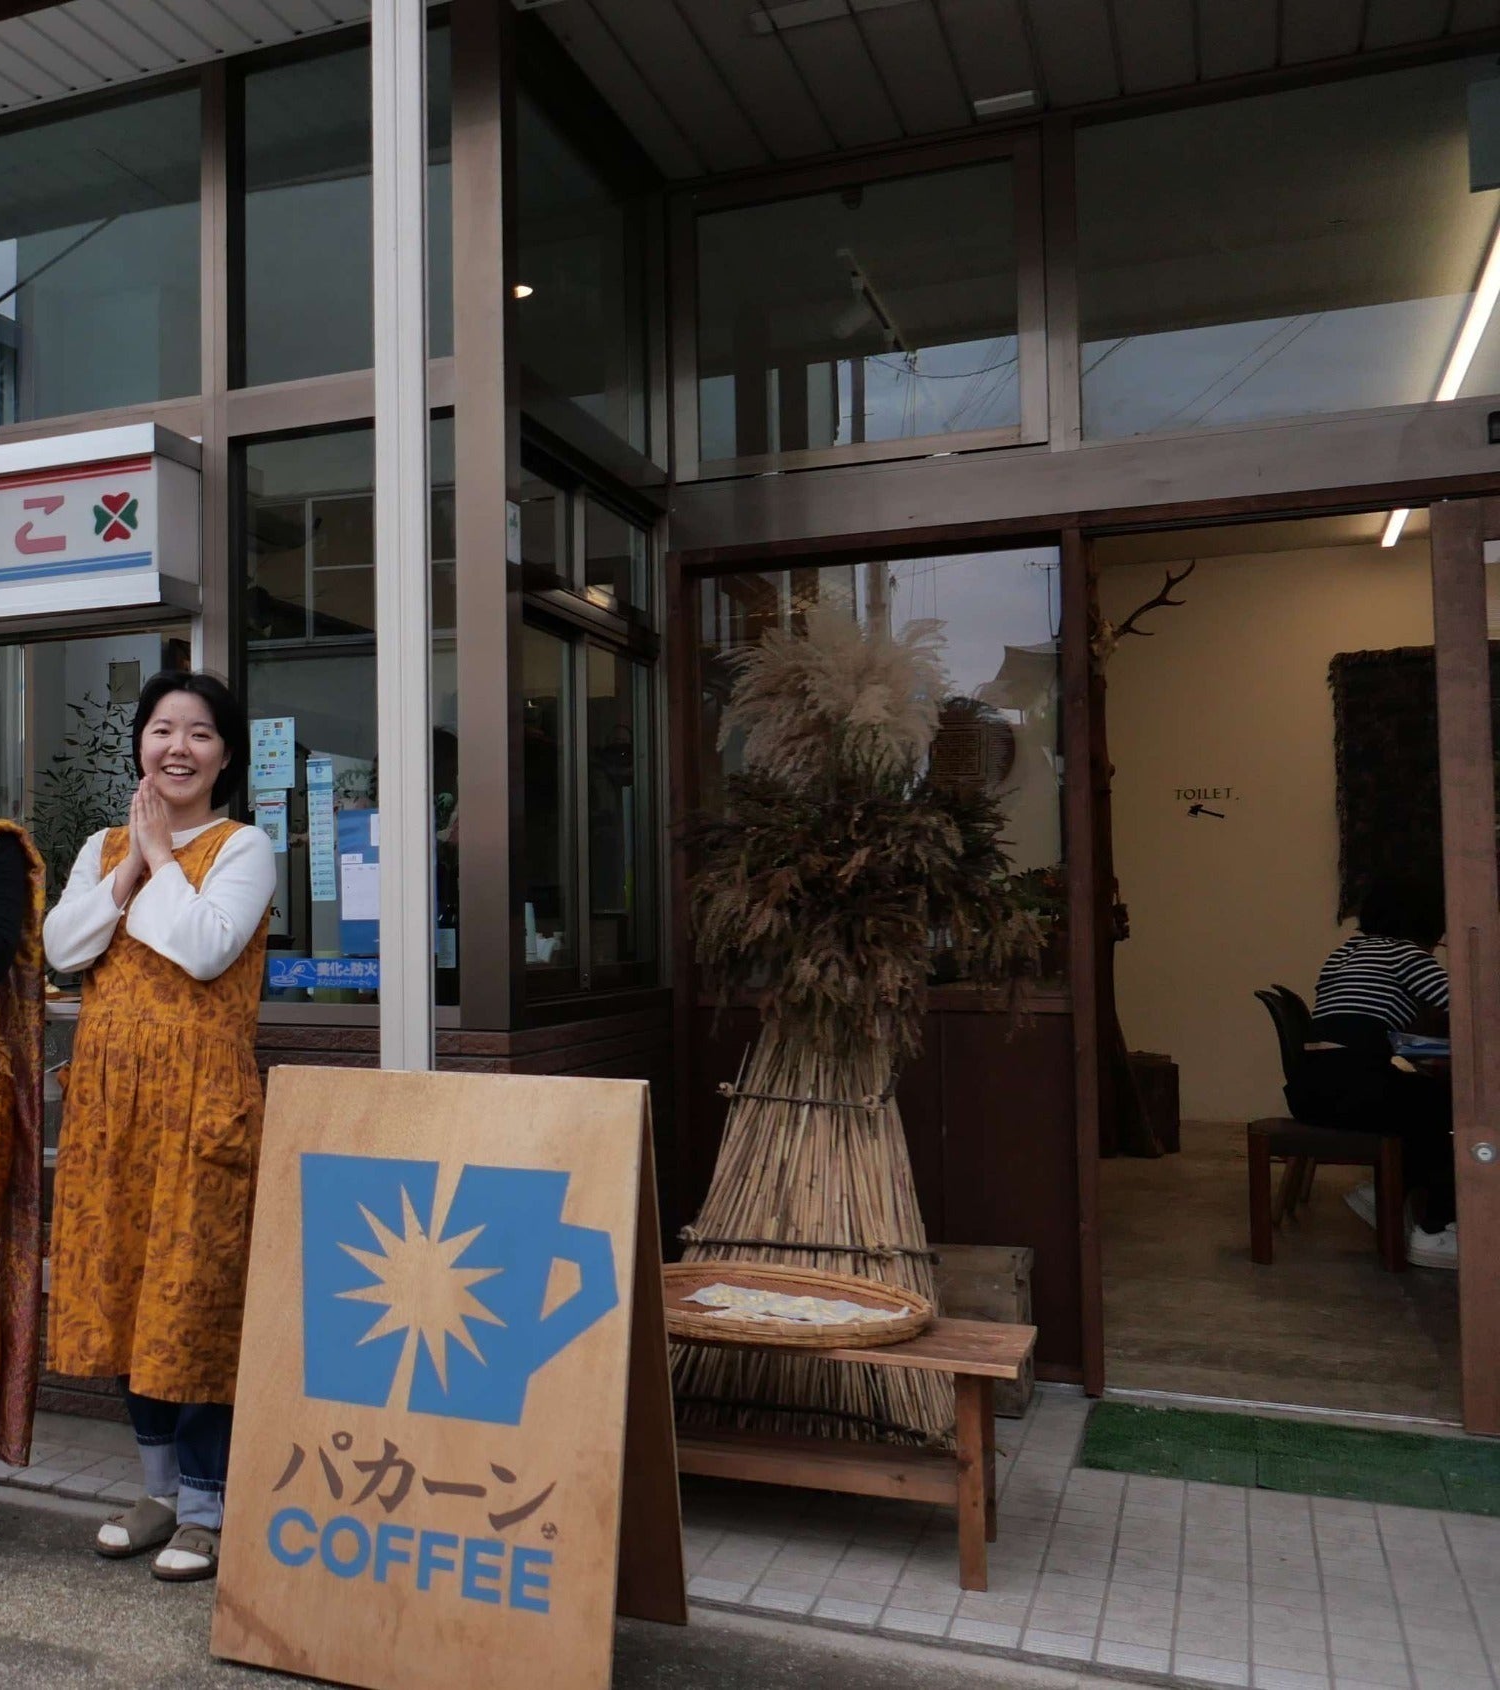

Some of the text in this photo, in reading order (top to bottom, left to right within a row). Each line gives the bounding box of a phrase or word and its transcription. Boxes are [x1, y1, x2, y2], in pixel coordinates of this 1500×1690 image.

[271, 1430, 557, 1534] パカーン
[266, 1506, 555, 1615] COFFEE
